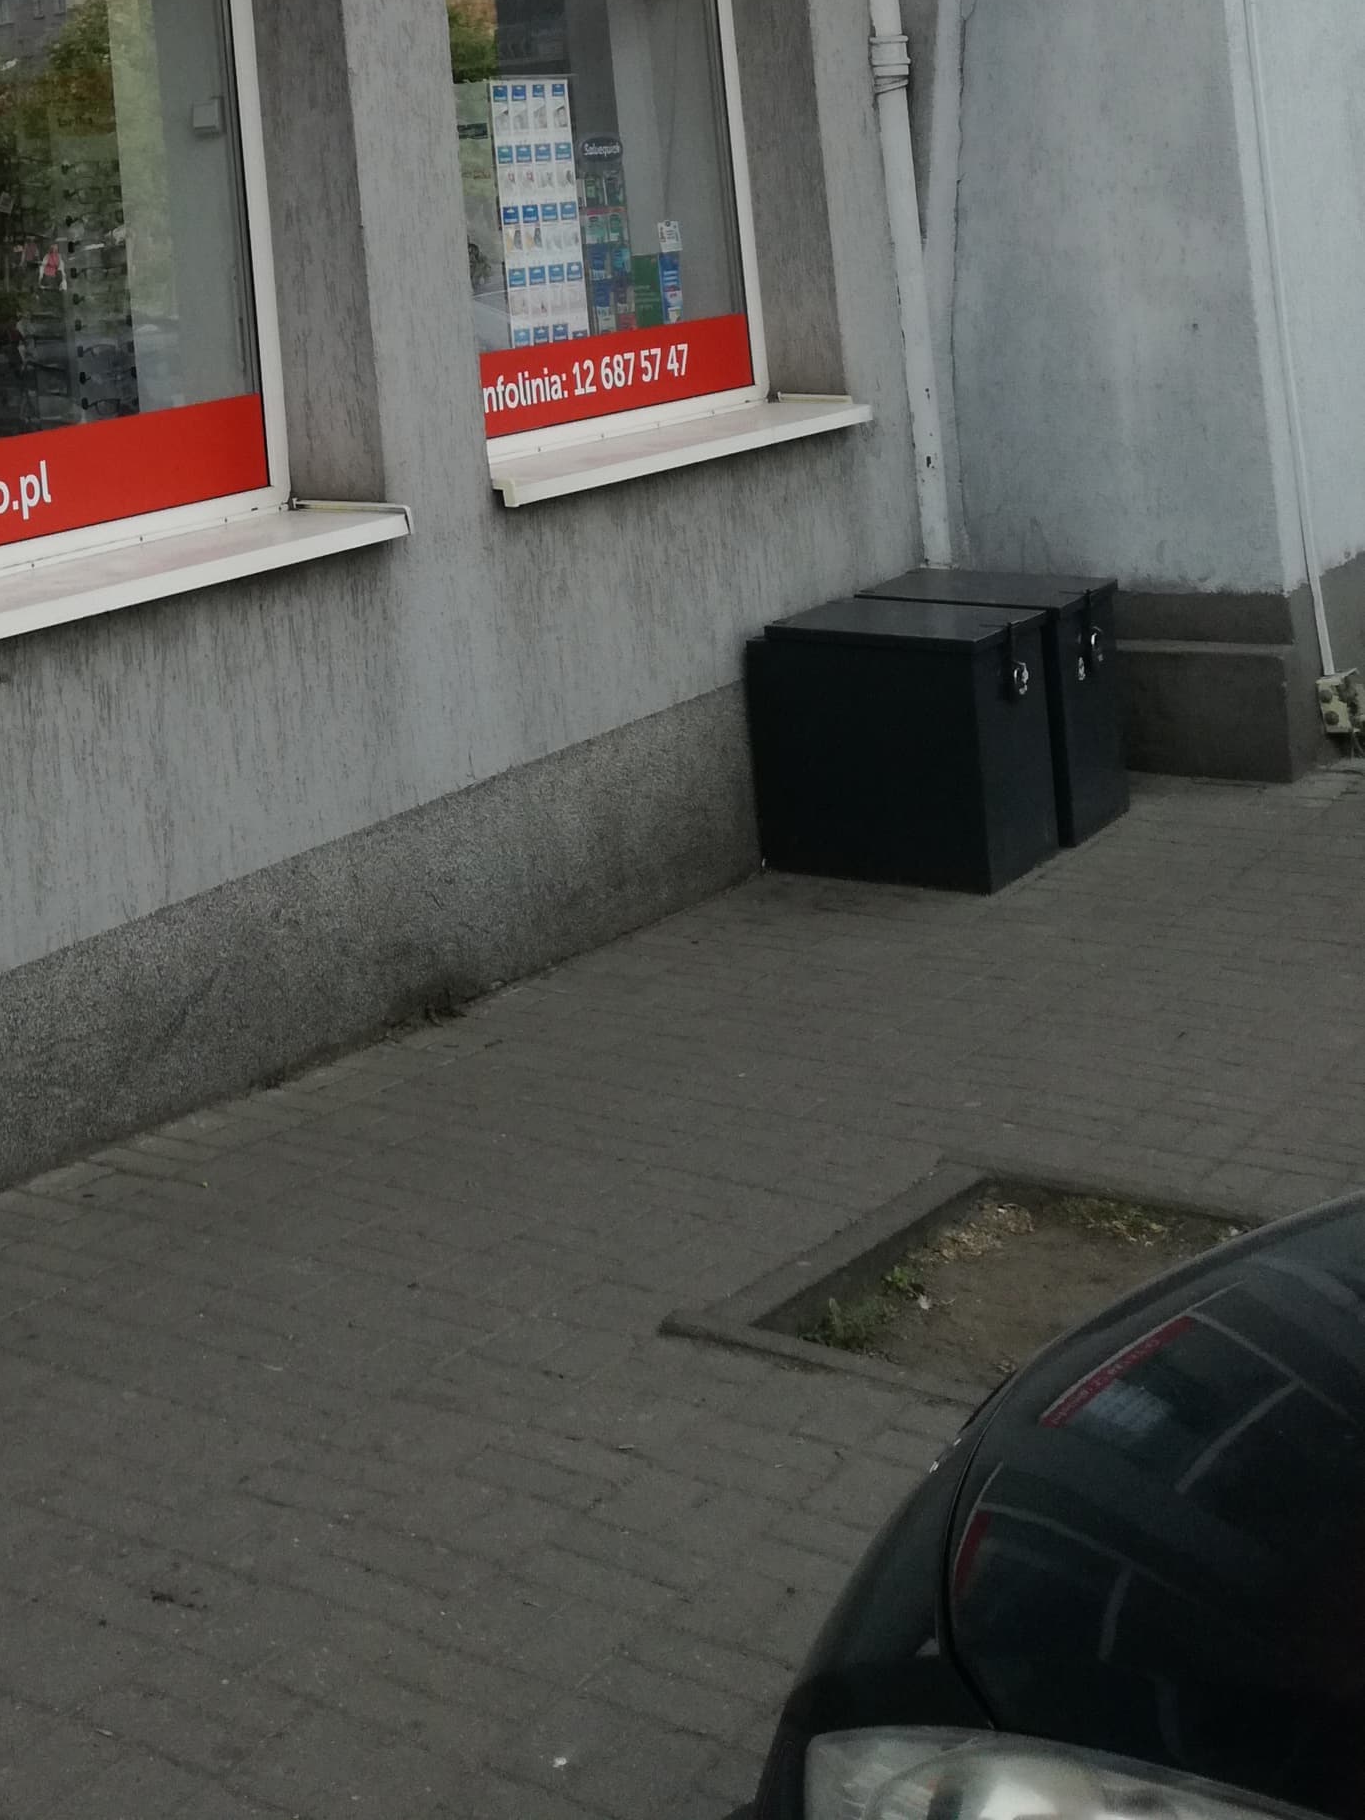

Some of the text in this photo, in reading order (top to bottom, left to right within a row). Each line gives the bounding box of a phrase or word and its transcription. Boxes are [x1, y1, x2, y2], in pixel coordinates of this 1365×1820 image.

[482, 342, 689, 414] nfolinia: 12 687 57 47
